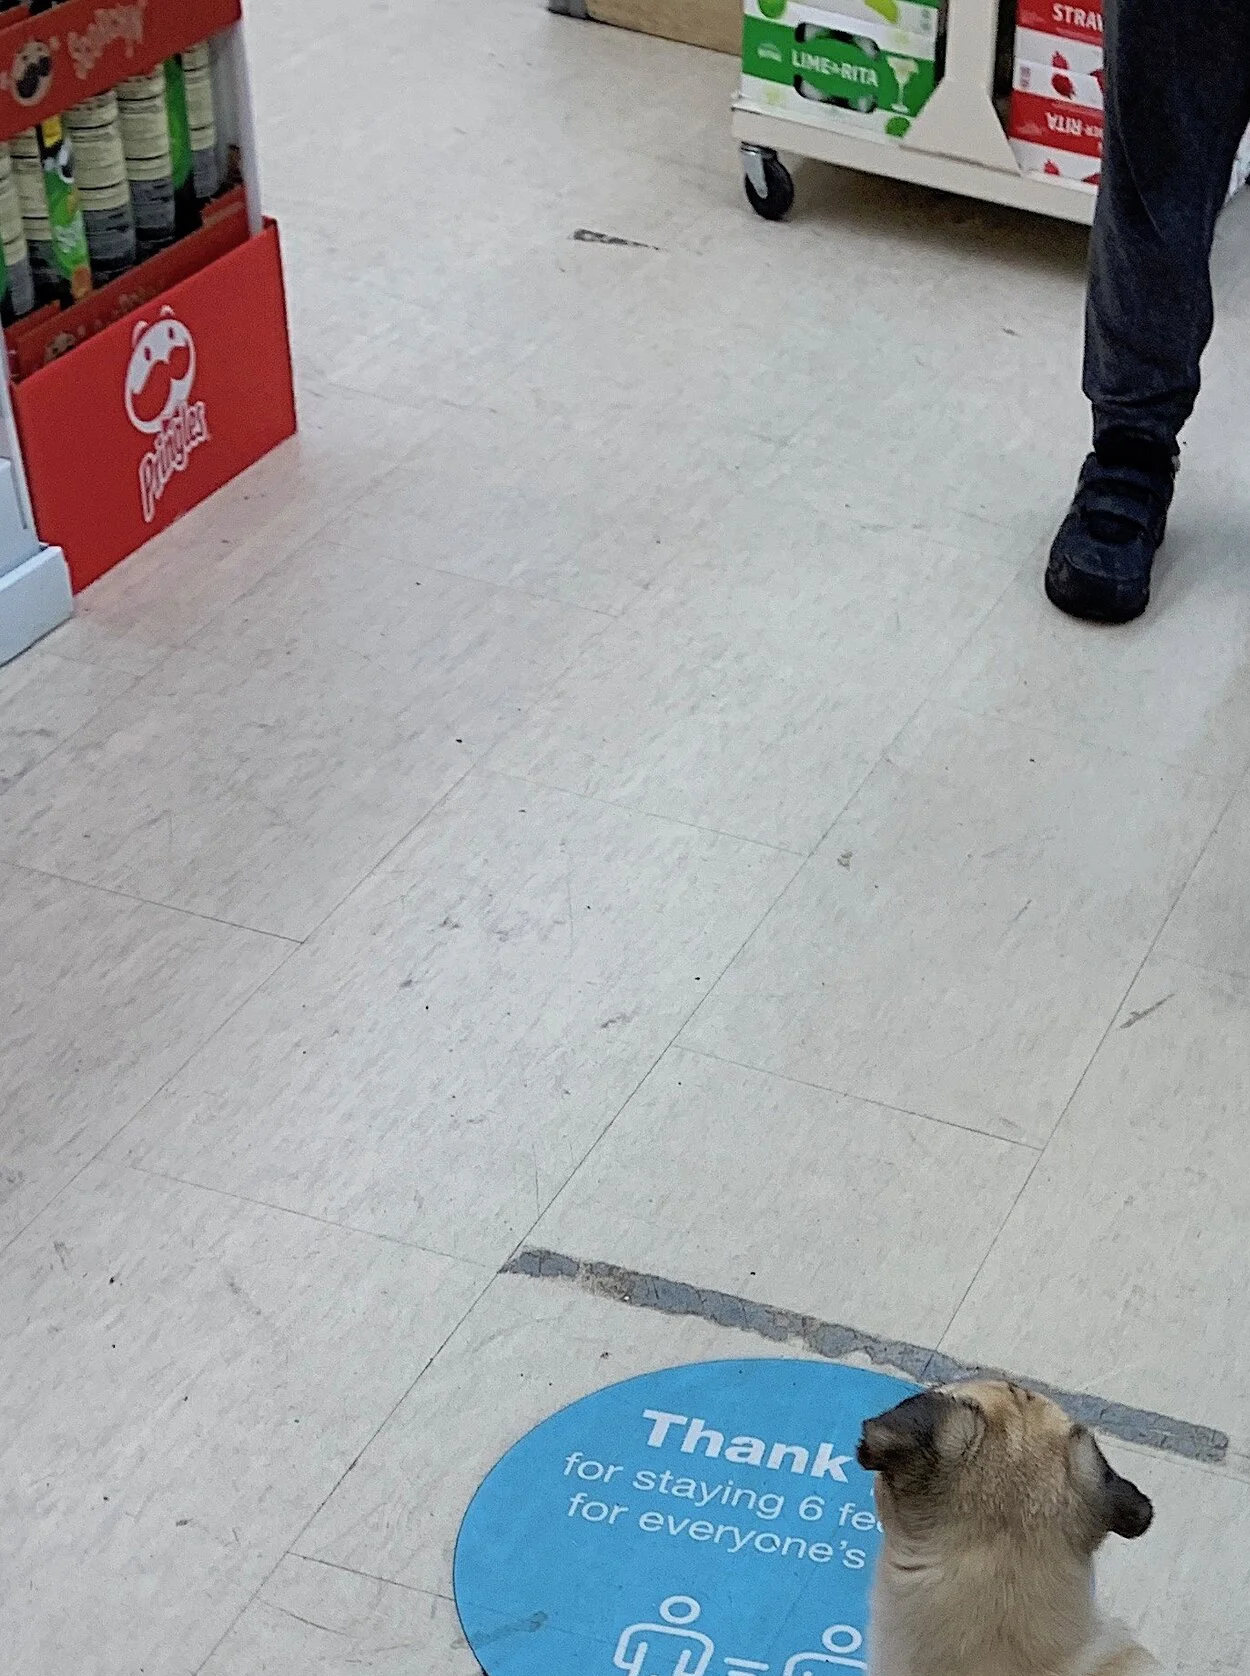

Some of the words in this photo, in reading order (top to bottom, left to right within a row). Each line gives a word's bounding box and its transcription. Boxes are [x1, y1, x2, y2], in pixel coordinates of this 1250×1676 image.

[139, 401, 211, 522] Pringles
[641, 1408, 856, 1484] Thank
[563, 1451, 624, 1484] for
[632, 1467, 786, 1521] staying
[798, 1495, 825, 1521] 6
[838, 1502, 884, 1534] fe
[567, 1492, 629, 1526] for
[638, 1511, 867, 1571] everyone's
